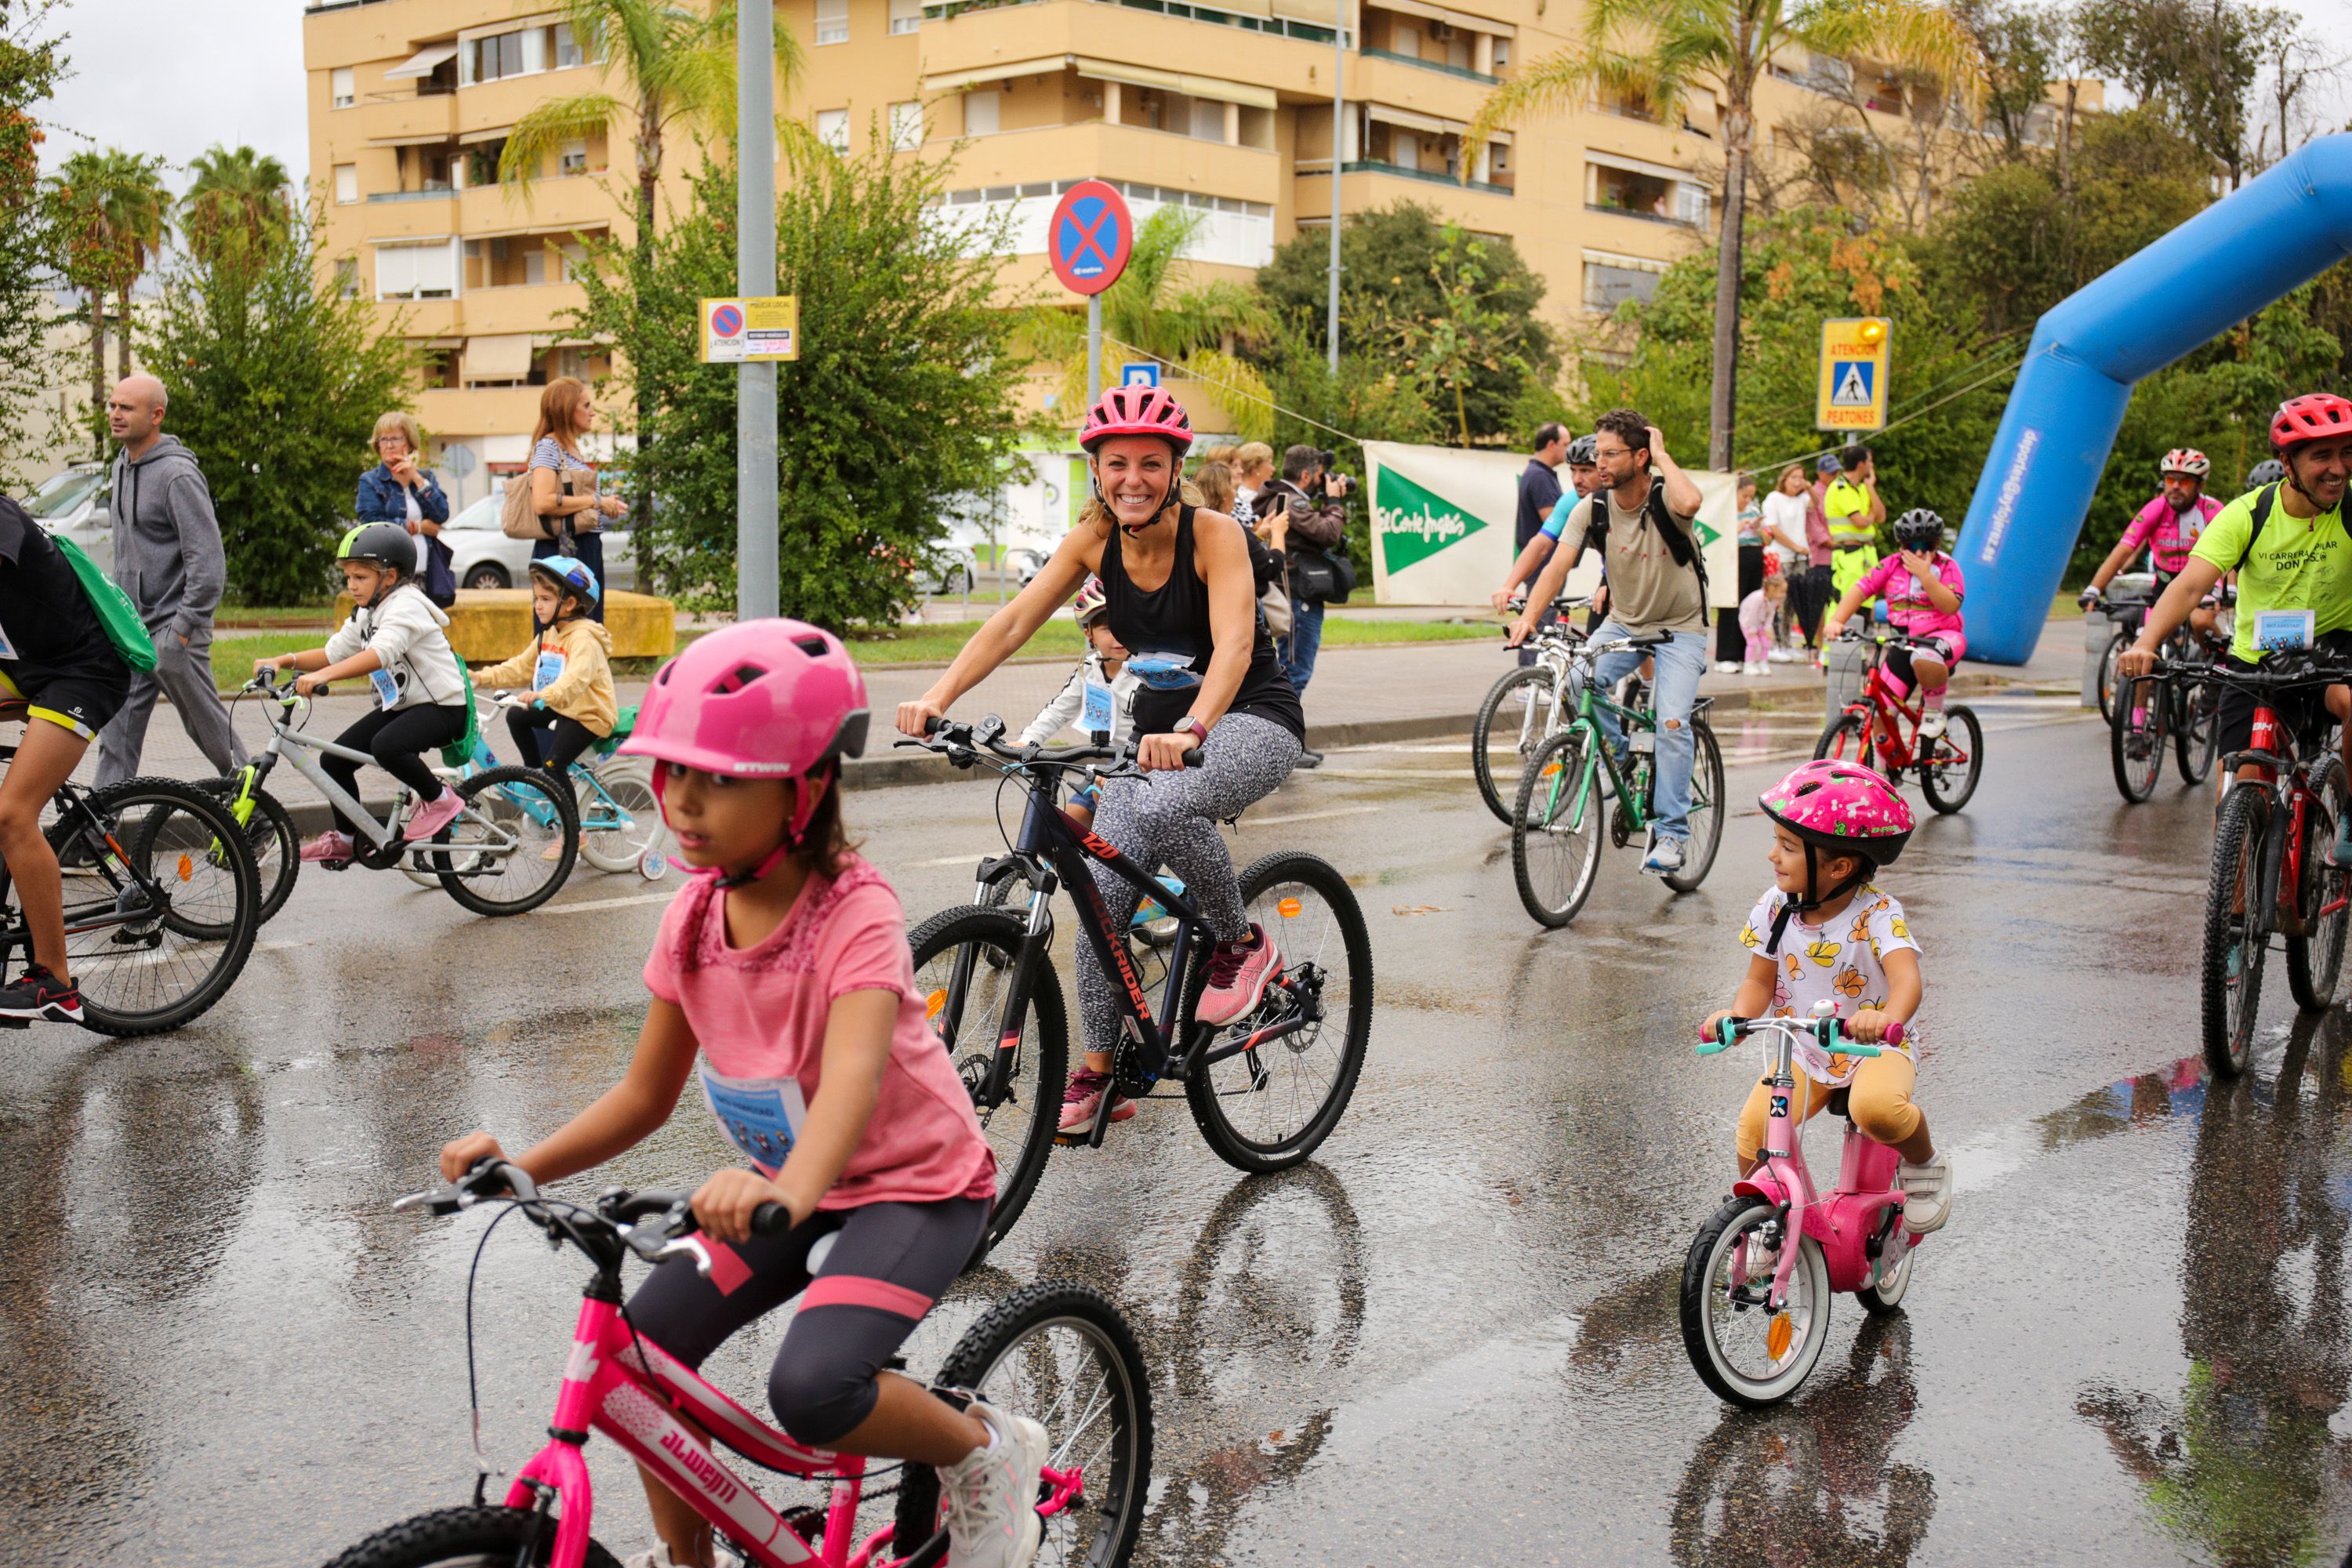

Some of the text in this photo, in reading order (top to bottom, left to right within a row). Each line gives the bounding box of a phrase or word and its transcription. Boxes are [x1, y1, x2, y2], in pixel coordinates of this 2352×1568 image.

[1827, 411, 1875, 424] PEATONES
[2276, 560, 2300, 571] DON
[1081, 831, 1120, 860] 120
[1084, 882, 1150, 1020] ROCKRIDER
